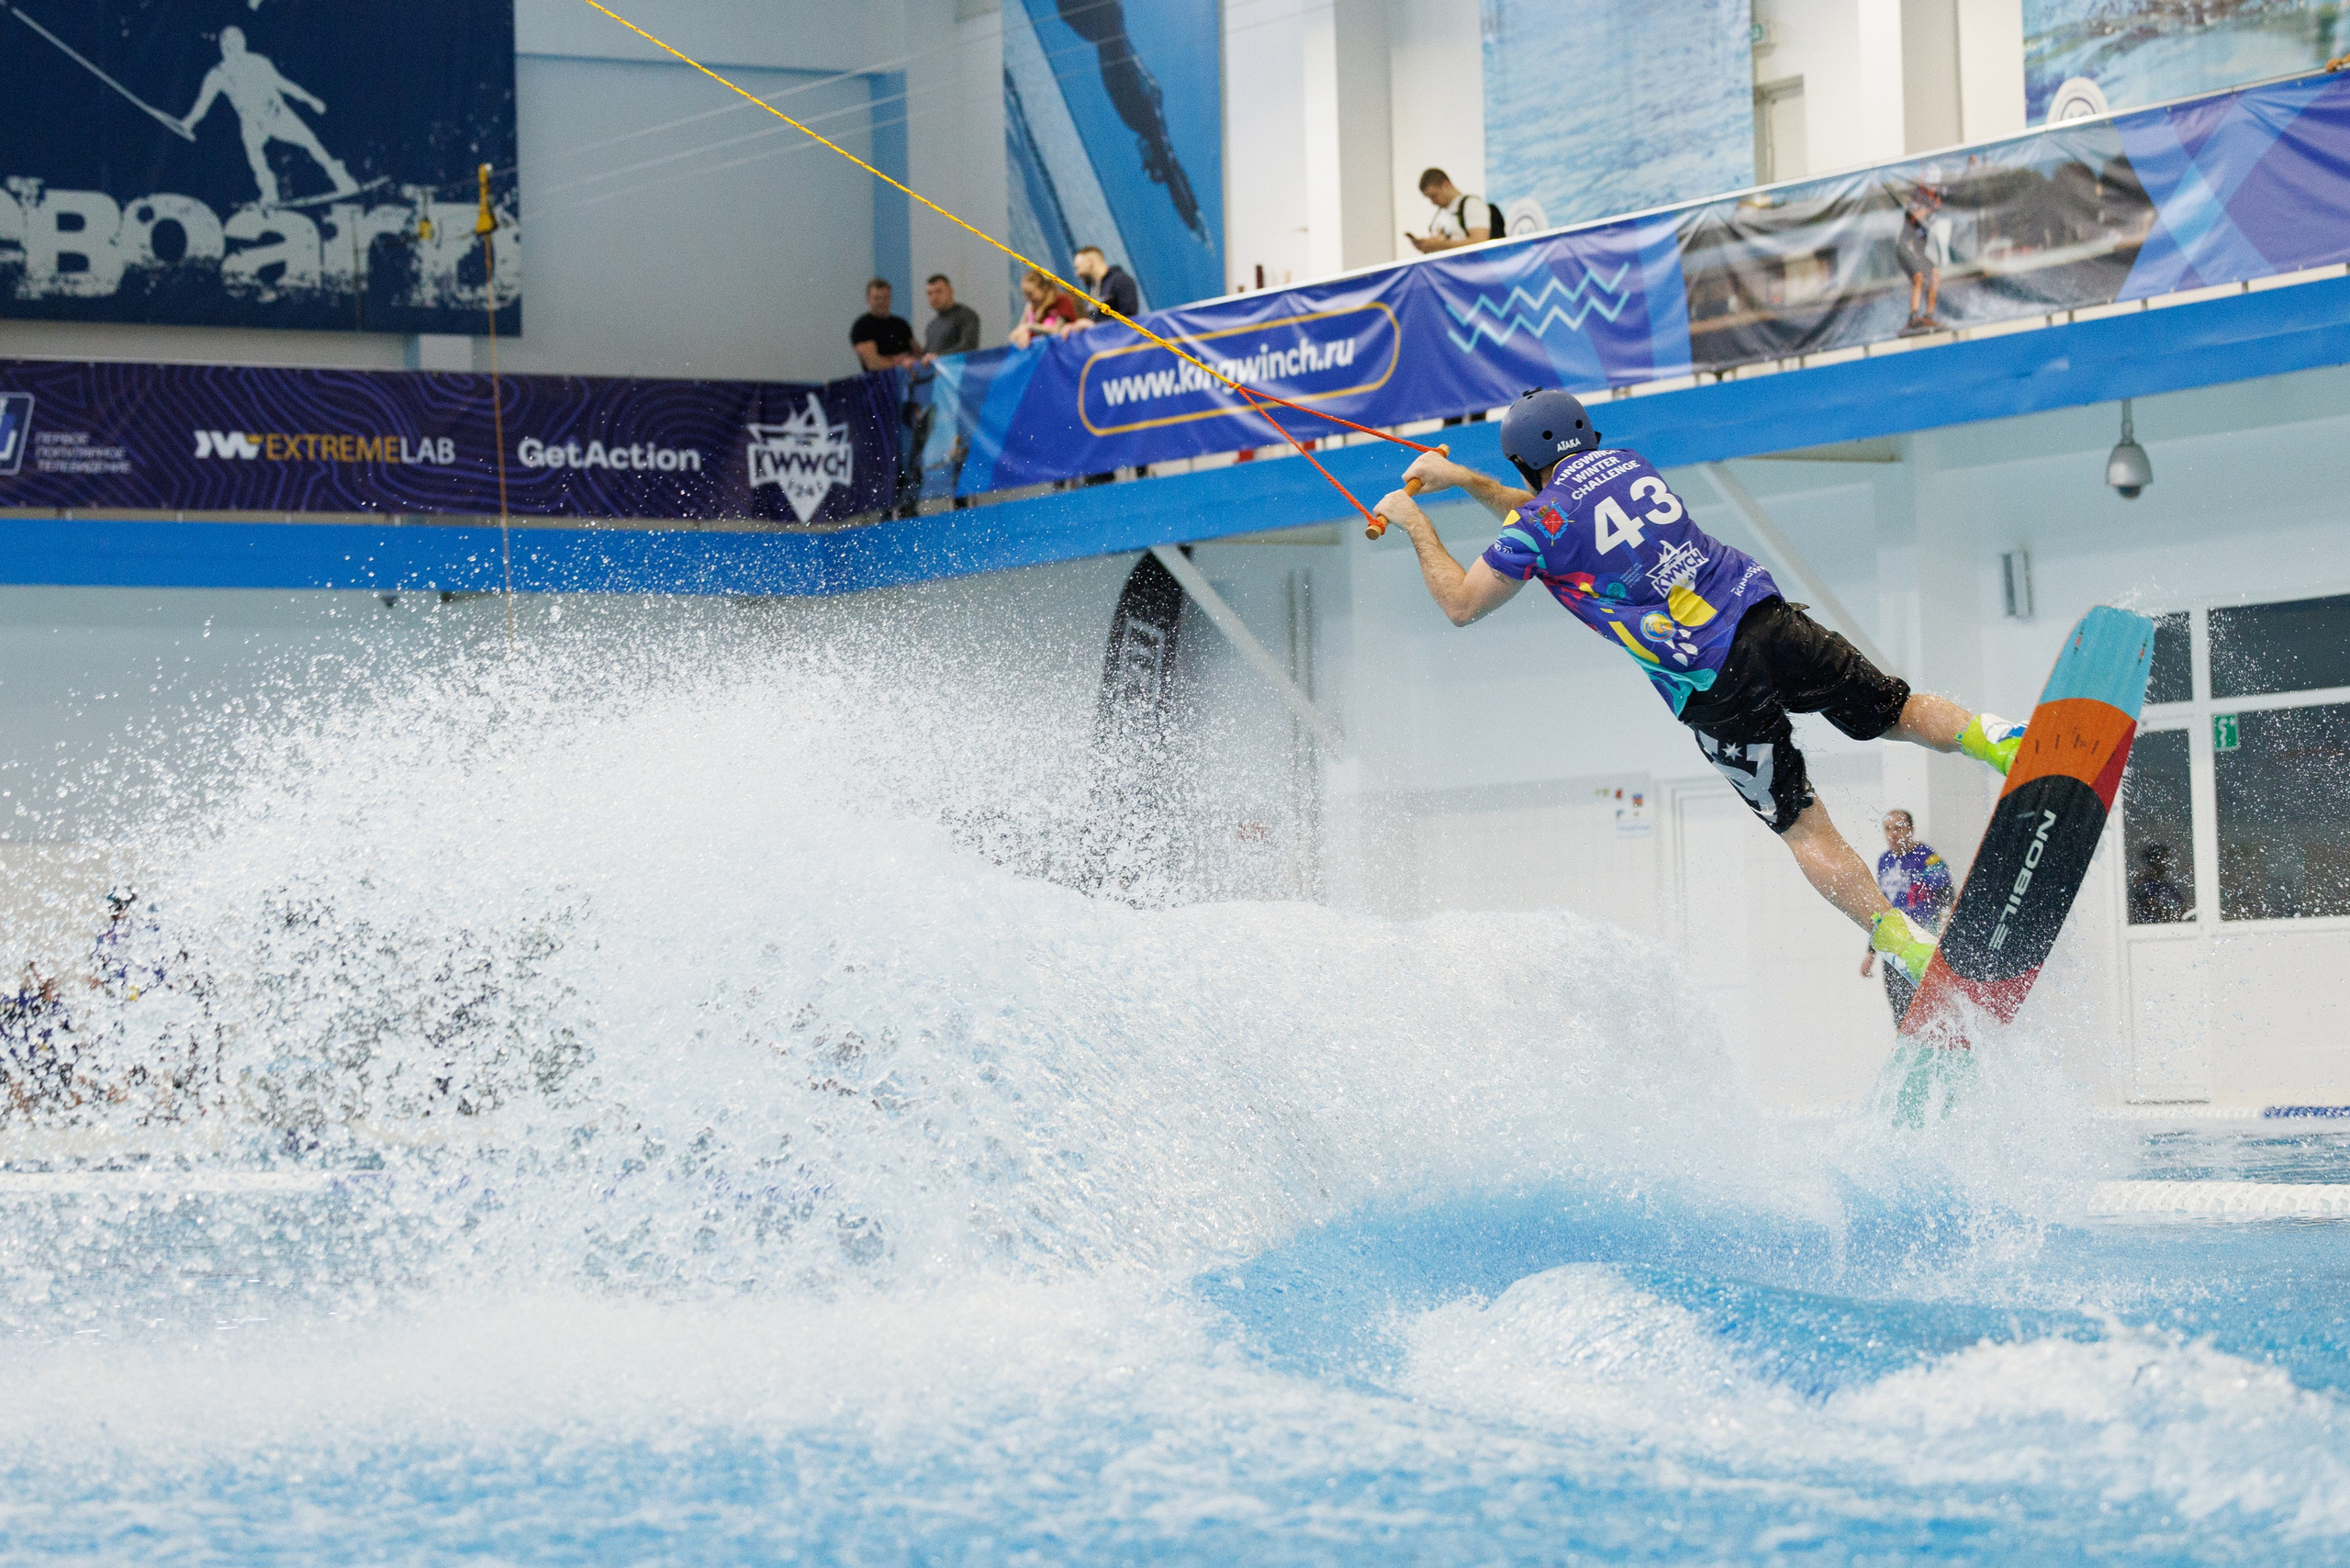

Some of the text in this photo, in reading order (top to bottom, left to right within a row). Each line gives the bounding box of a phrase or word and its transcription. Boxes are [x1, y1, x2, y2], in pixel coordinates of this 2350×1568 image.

[1102, 338, 1355, 407] www.kingwinch.ru
[517, 437, 702, 472] GetAction
[1557, 438, 1582, 453] ATAKA
[1553, 449, 1621, 486] KINGWINC
[1571, 456, 1621, 484] WINTER
[1571, 460, 1641, 500] CHALLENGE
[1595, 476, 1683, 555] 43
[1653, 549, 1706, 598] KWWCH
[1988, 809, 2057, 950] NOBILE
